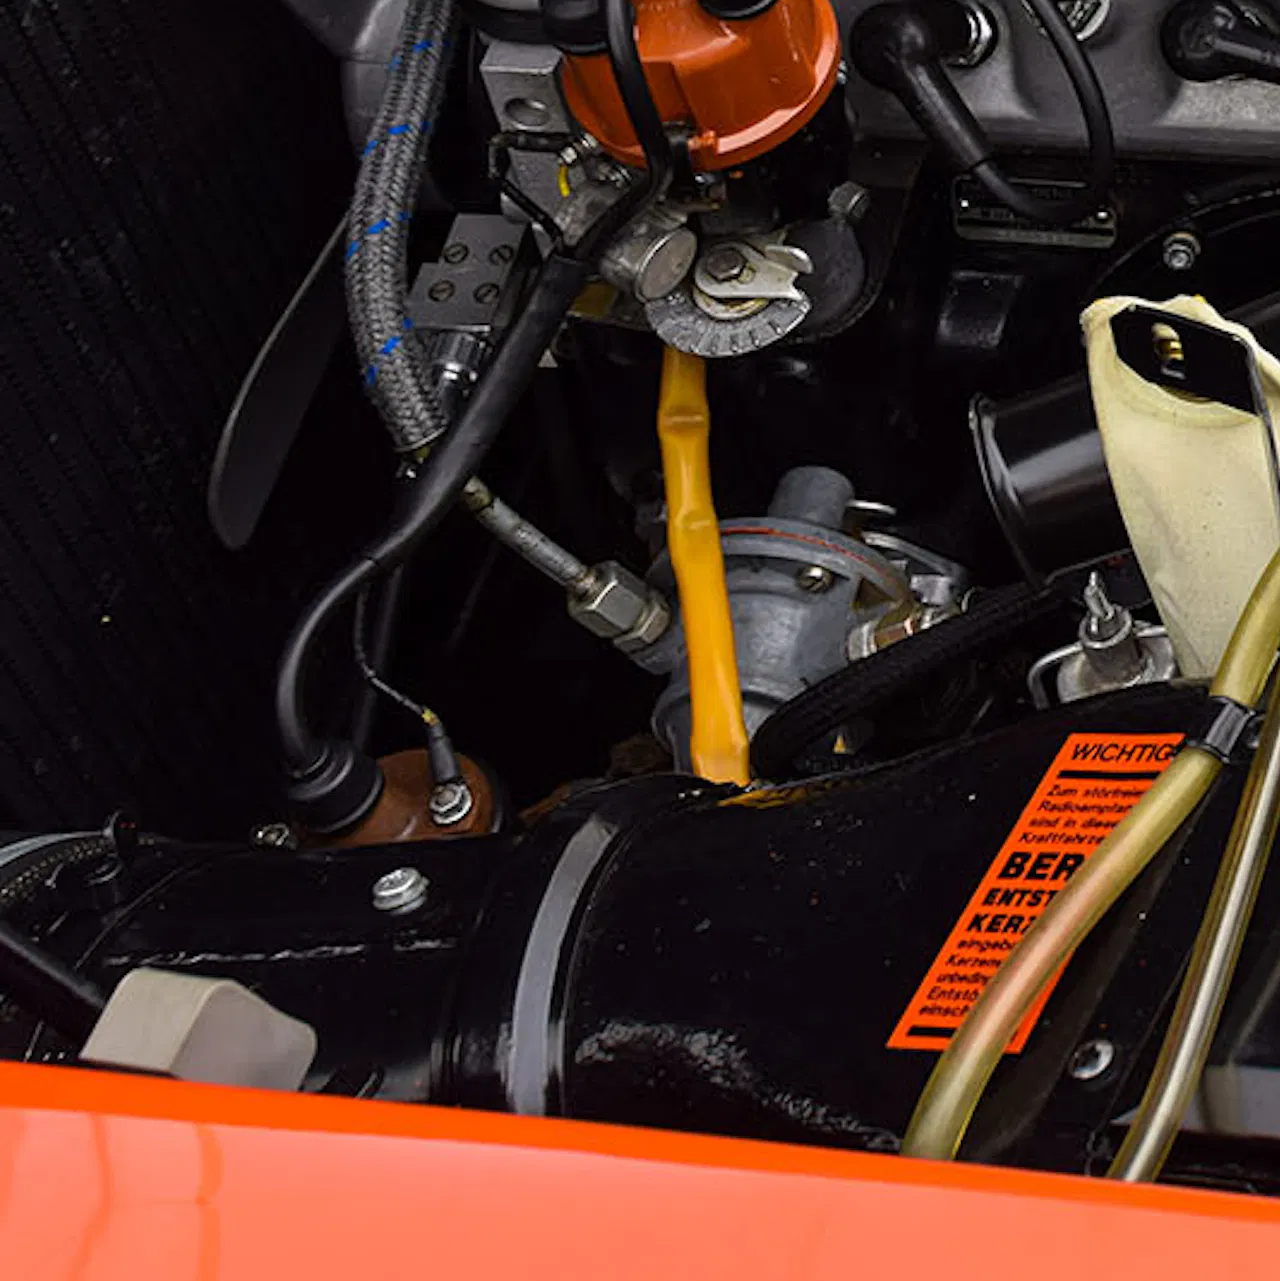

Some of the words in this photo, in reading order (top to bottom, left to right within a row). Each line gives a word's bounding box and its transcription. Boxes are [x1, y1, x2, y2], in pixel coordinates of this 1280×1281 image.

[1047, 784, 1078, 797] Zum
[1082, 818, 1117, 829] diese
[1018, 831, 1105, 845] Kraftfahrze
[997, 851, 1085, 881] BER
[981, 887, 1059, 907] ENTST
[927, 985, 980, 1002] Entstö
[919, 1003, 971, 1017] einsch
